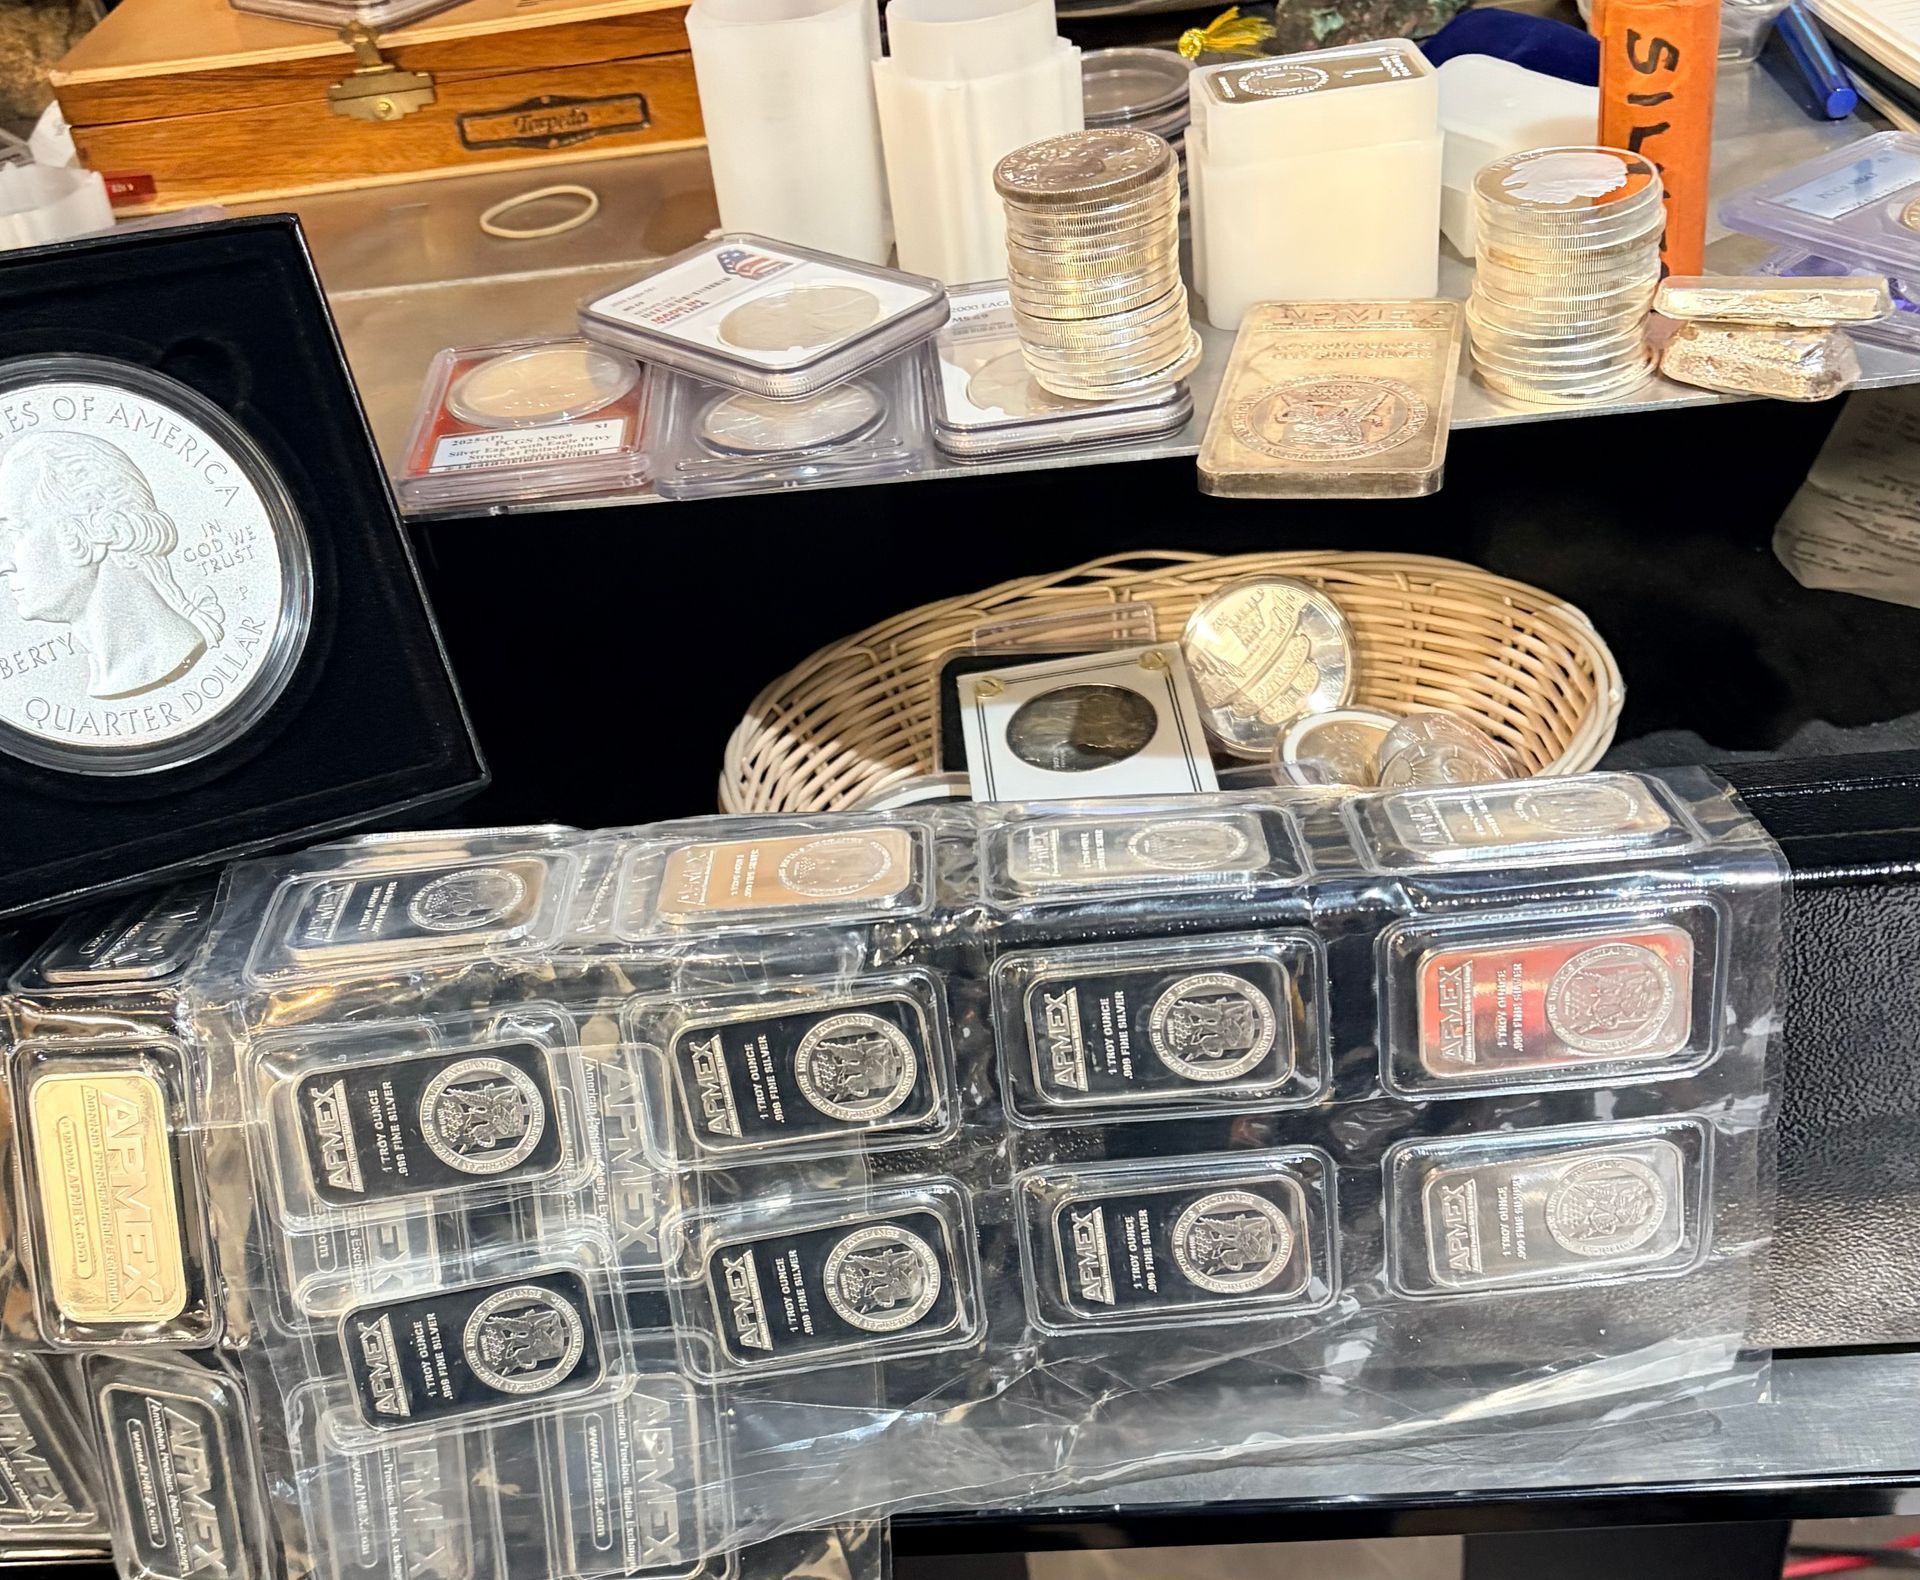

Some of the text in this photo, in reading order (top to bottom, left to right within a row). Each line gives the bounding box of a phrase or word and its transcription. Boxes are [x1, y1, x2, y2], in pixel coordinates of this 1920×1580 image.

[52, 396, 95, 422] OF
[106, 402, 240, 508] AMERICA
[447, 449, 480, 457] Silver
[484, 445, 514, 453] Eagle
[547, 437, 577, 446] Eagle
[580, 433, 611, 443] Privy
[468, 451, 505, 460] Struck
[524, 440, 594, 454] Philadelphia
[494, 437, 533, 446] PCGS
[183, 525, 258, 564] GOD WE
[201, 518, 222, 538] IN
[196, 548, 255, 577] TRUST
[25, 615, 267, 737] QUARTER DOLLAR
[1100, 998, 1112, 1035] OUNCE
[1114, 990, 1126, 1028] SILVER
[757, 1035, 773, 1073] SILVER
[1043, 993, 1076, 1087] APMEX
[1104, 1038, 1116, 1066] TROY
[1119, 1031, 1130, 1055] FINE
[744, 1043, 760, 1080] OUNCE
[382, 1080, 397, 1121] SILVER
[688, 1040, 730, 1134] APMEX
[752, 1084, 766, 1111] TROY
[766, 1075, 779, 1099] FINE
[368, 1089, 384, 1130] OUNCE
[310, 1086, 351, 1189] APMEX
[375, 1133, 390, 1163] TROY
[390, 1124, 403, 1150] FINE
[600, 1063, 657, 1252] APMEX
[100, 1091, 162, 1302] APMEX
[1124, 1216, 1137, 1251] OUNCE
[1138, 1209, 1150, 1245] SILVER
[1442, 1184, 1470, 1270] APMEX
[788, 1249, 803, 1286] SILVER
[1071, 1212, 1103, 1301] APMEX
[1129, 1254, 1141, 1280] TROY
[1143, 1247, 1154, 1270] FINE
[775, 1257, 790, 1294] OUNCE
[722, 1256, 761, 1347] APMEX
[783, 1297, 796, 1324] TROY
[796, 1288, 809, 1312] FINE
[412, 1320, 428, 1358] OUNCE
[426, 1312, 442, 1350] SILVER
[357, 1320, 398, 1413] APMEX
[421, 1361, 435, 1389] TROY
[434, 1351, 448, 1376] FINE
[631, 1392, 681, 1565] APMEX
